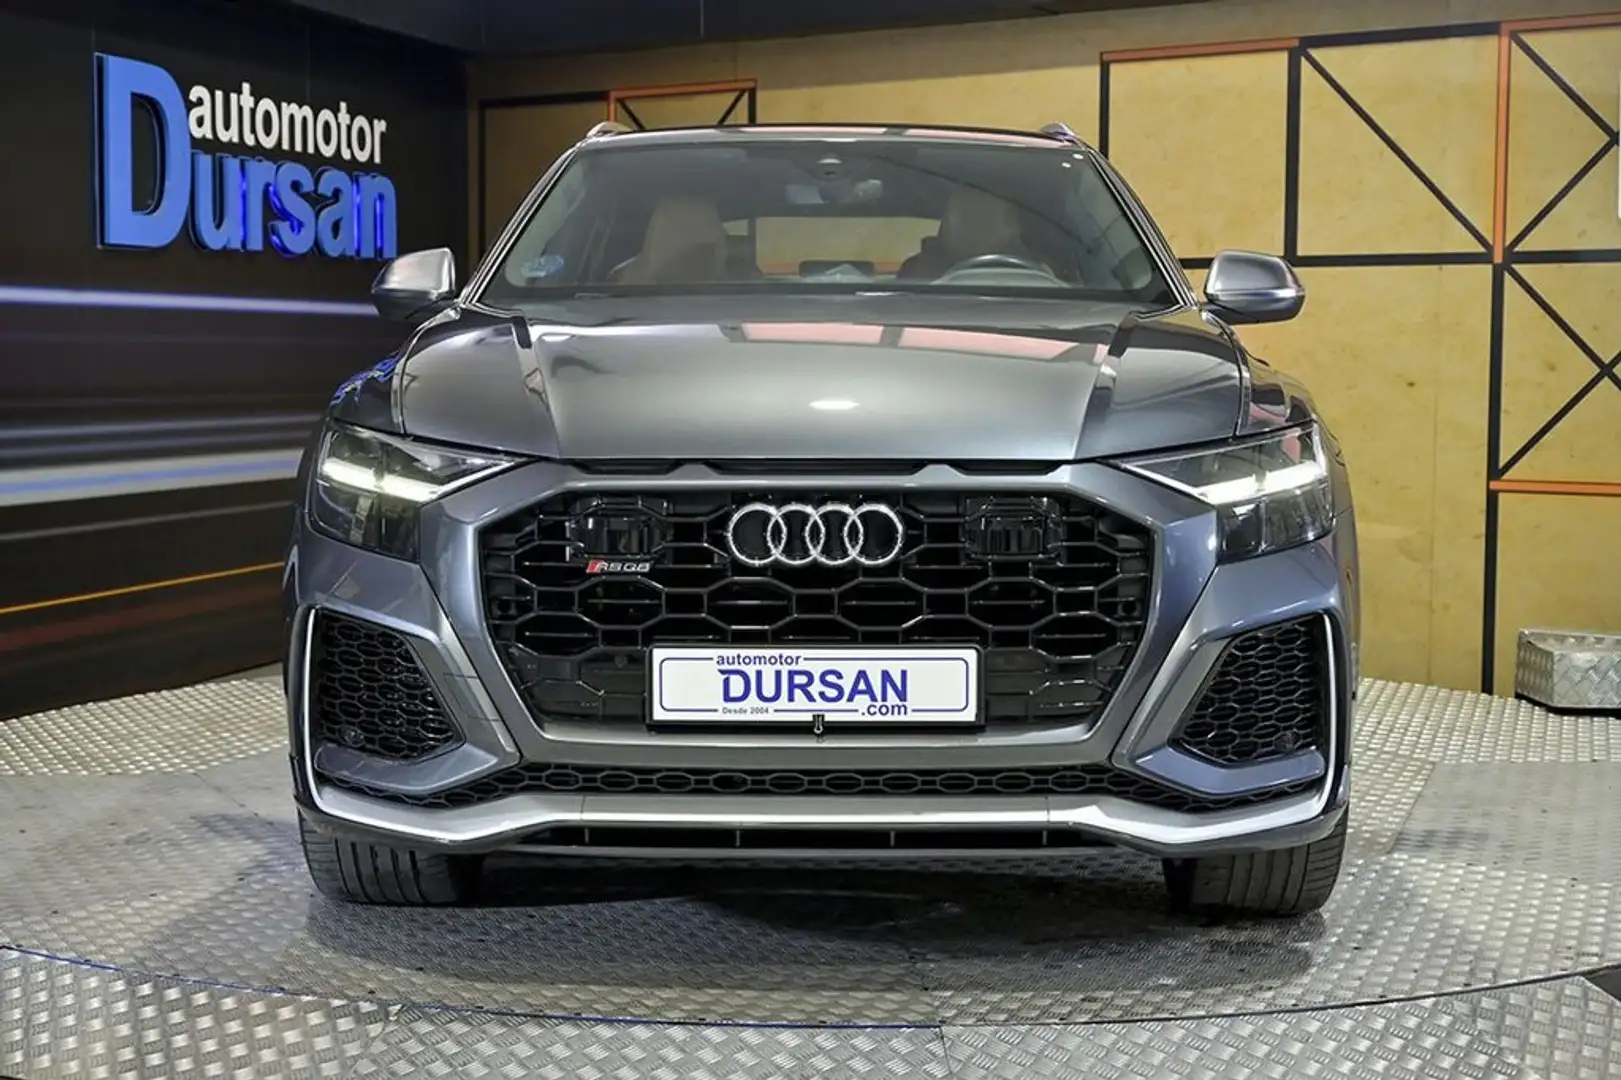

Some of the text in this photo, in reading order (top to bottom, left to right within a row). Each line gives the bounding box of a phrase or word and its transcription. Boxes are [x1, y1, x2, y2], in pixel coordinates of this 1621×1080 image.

[188, 82, 387, 164] automotor
[94, 52, 398, 259] Dursan
[716, 653, 801, 666] automotor
[717, 669, 908, 703] DURSAN
[722, 706, 769, 714] Desde 2004
[861, 701, 908, 716] .com
